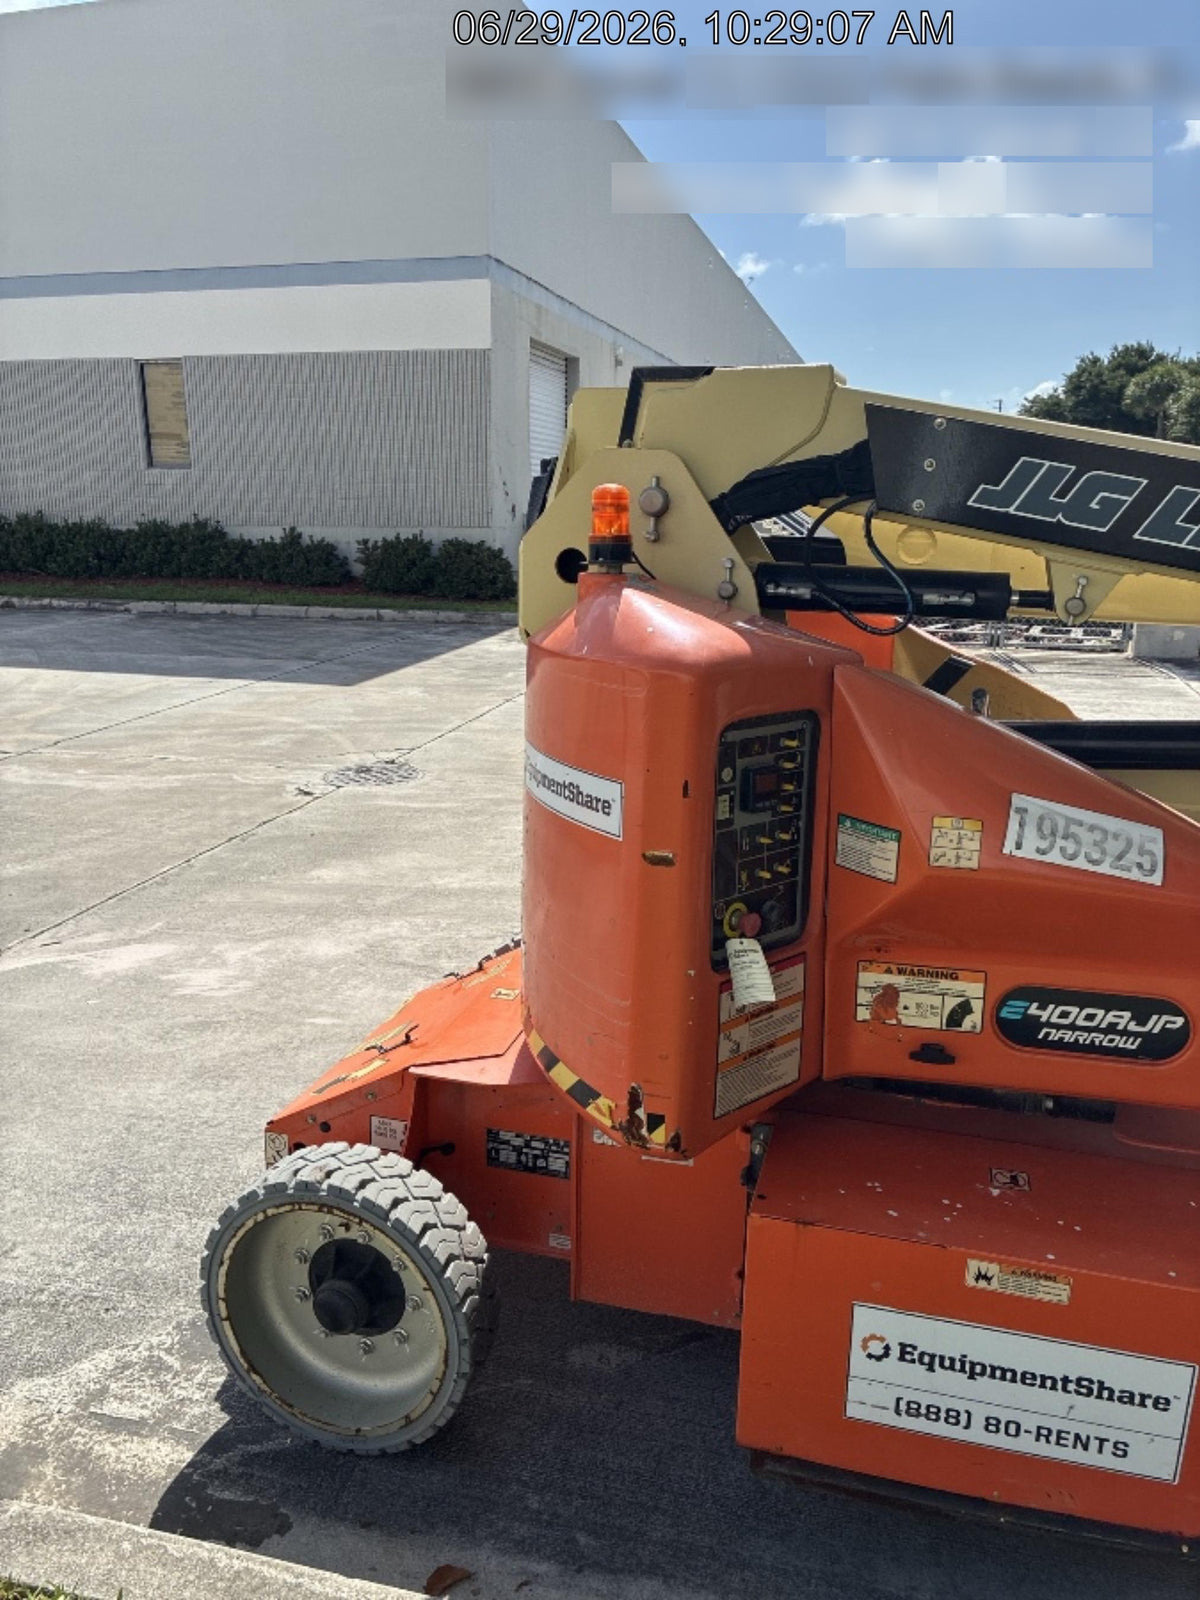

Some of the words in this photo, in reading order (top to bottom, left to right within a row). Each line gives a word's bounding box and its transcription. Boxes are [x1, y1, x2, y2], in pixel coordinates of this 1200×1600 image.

[967, 456, 1149, 532] JLG
[1132, 484, 1200, 551] L
[1011, 805, 1160, 878] 195325
[896, 966, 960, 981] WARNING
[1037, 1027, 1142, 1049] NARROW
[894, 1396, 973, 1430] (888)
[983, 1416, 1131, 1459] 80-RENTS
